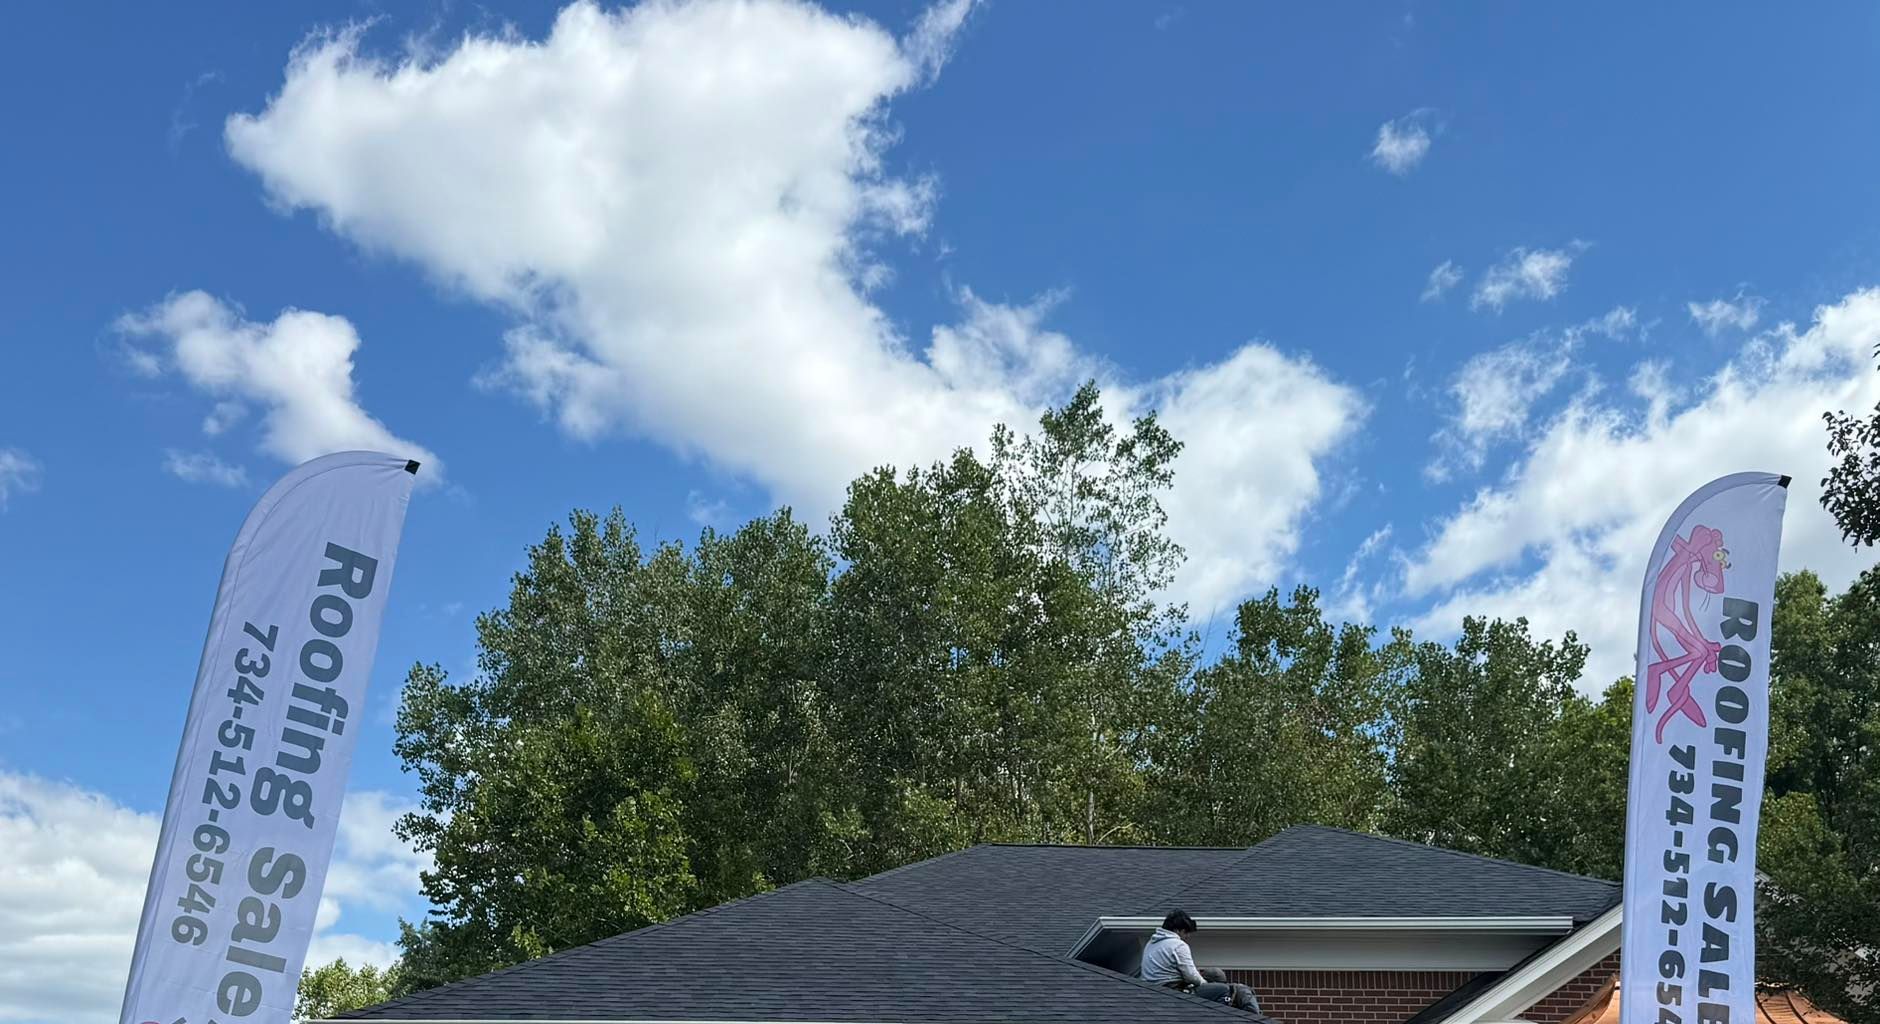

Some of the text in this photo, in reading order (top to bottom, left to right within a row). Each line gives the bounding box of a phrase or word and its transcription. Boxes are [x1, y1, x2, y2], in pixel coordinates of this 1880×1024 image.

[170, 621, 280, 946] 734-512-6546
[216, 541, 379, 1018] Roofing Sale
[1707, 596, 1760, 864] ROOFING
